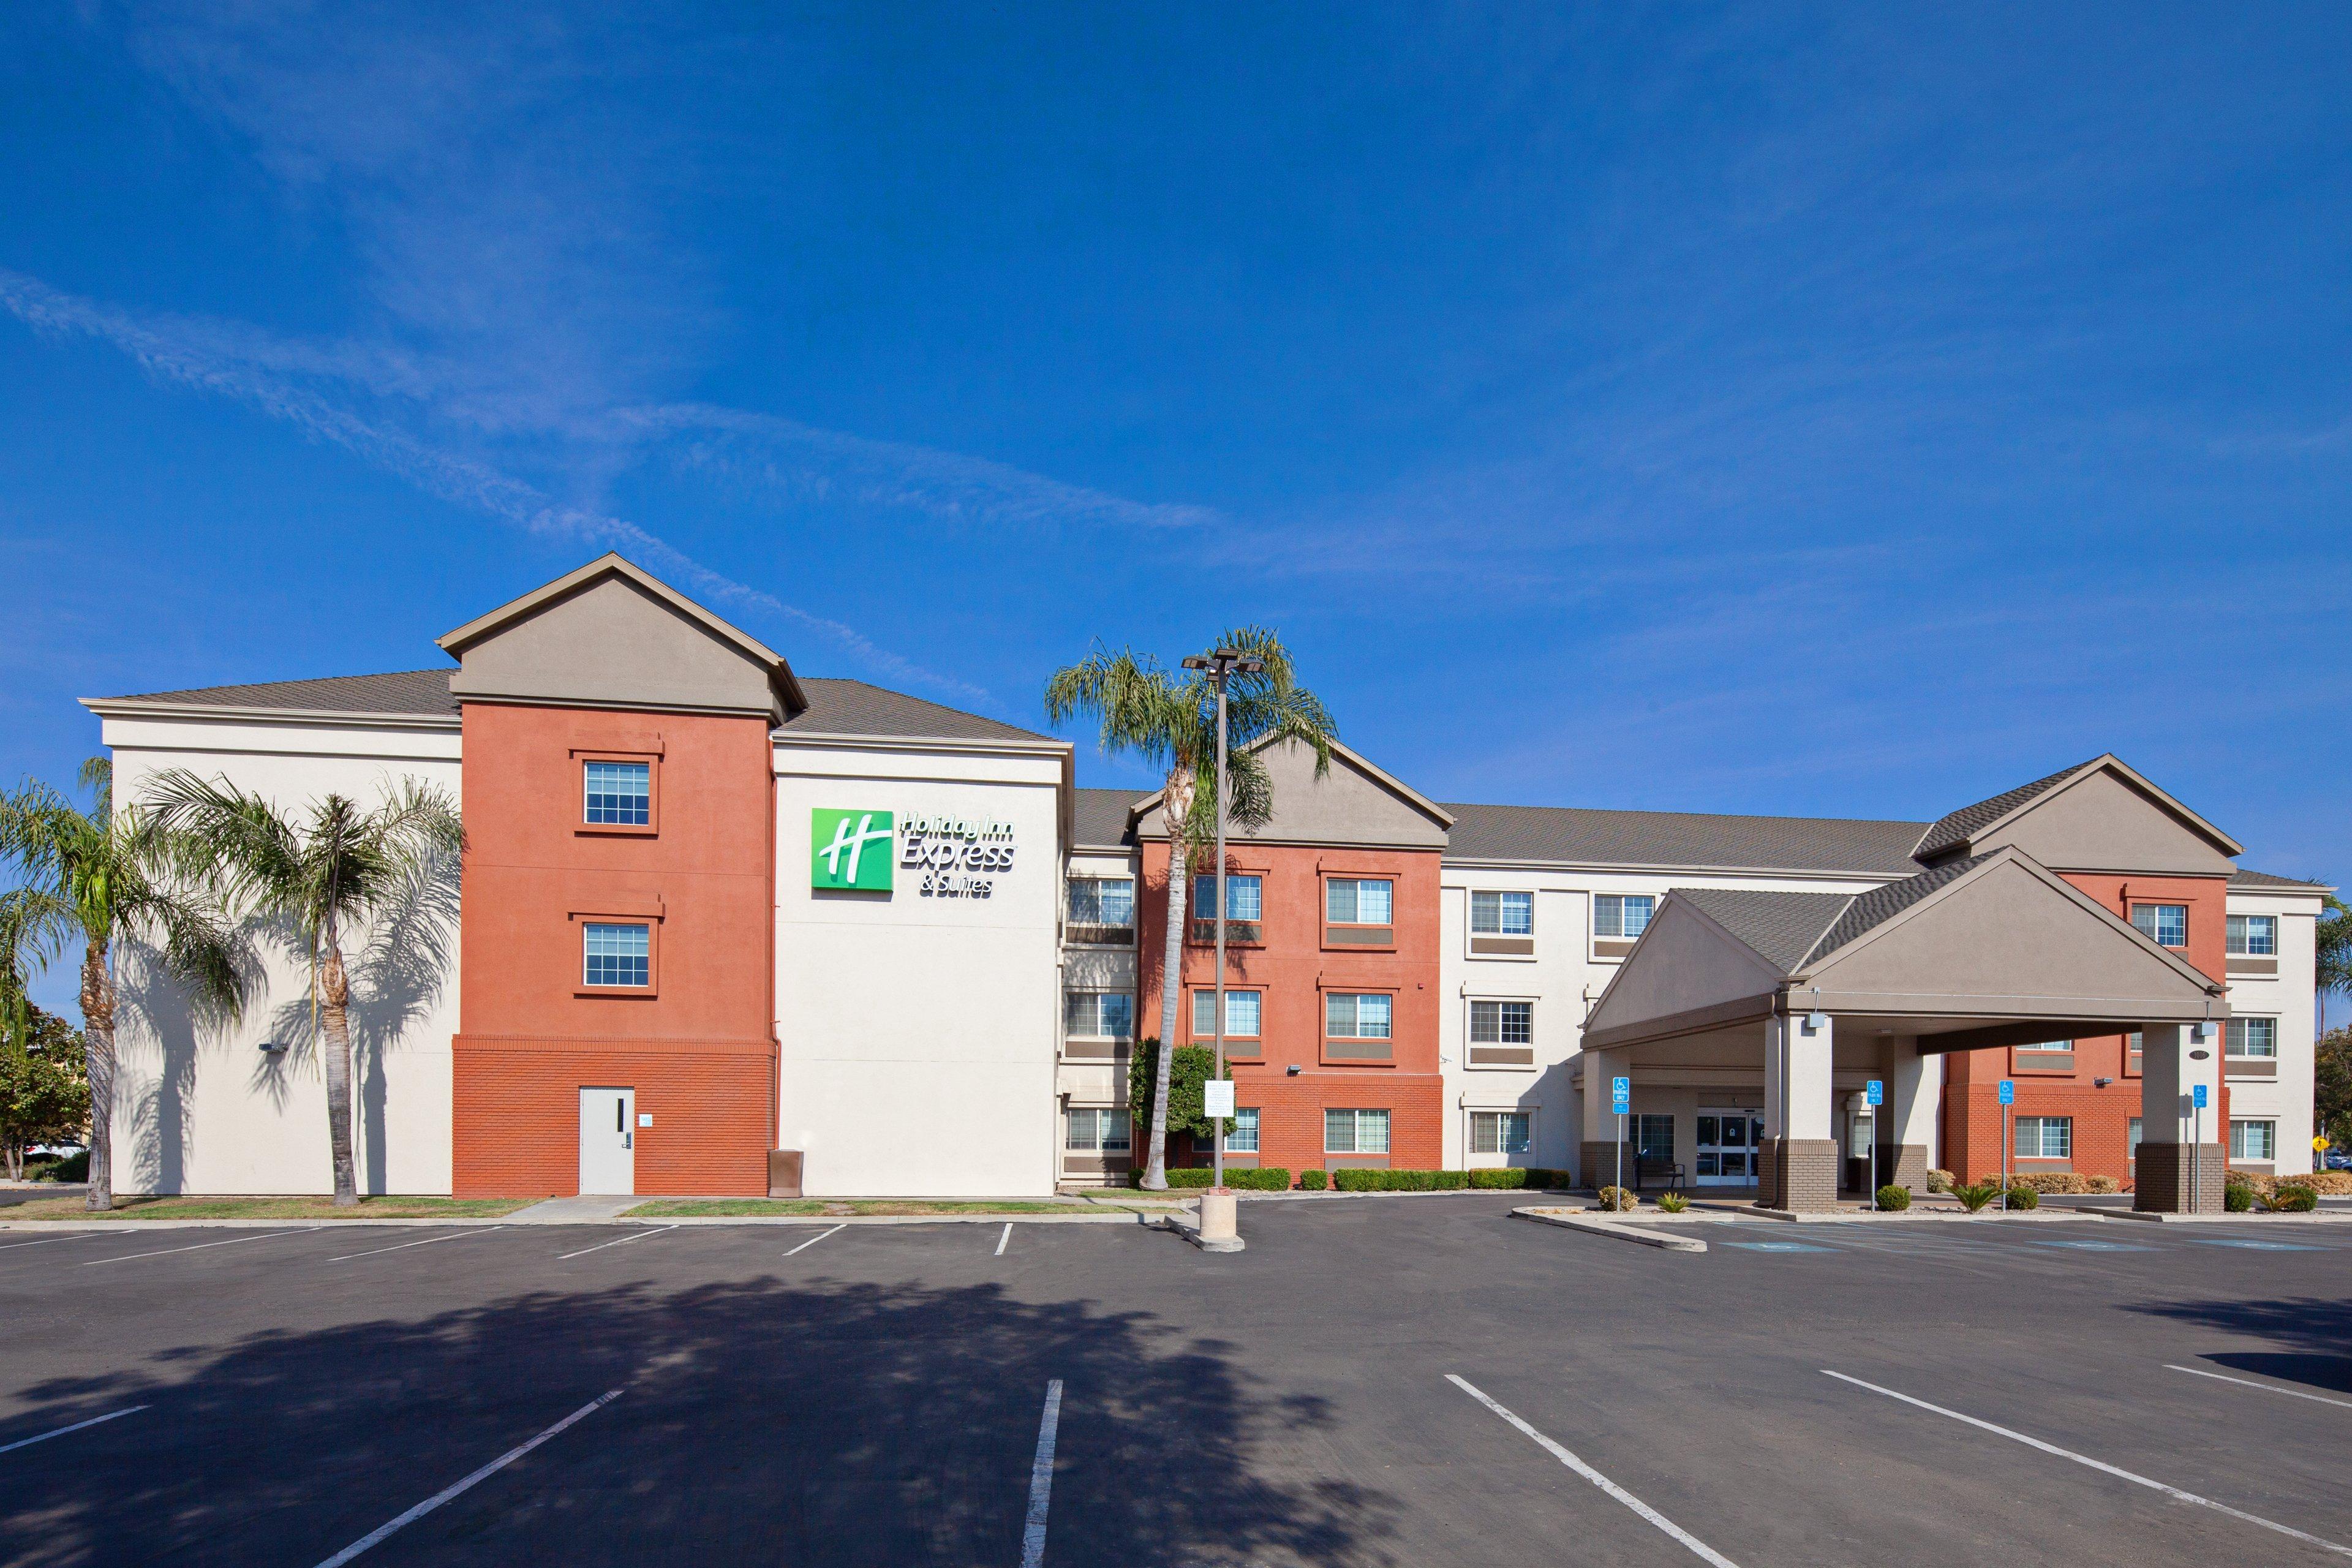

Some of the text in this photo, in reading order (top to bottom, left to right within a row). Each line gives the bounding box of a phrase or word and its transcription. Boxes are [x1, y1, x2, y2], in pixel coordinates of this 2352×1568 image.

[900, 811, 1014, 839] Holiday Inn
[900, 835, 1015, 872] Express
[920, 873, 992, 893] & Suites
